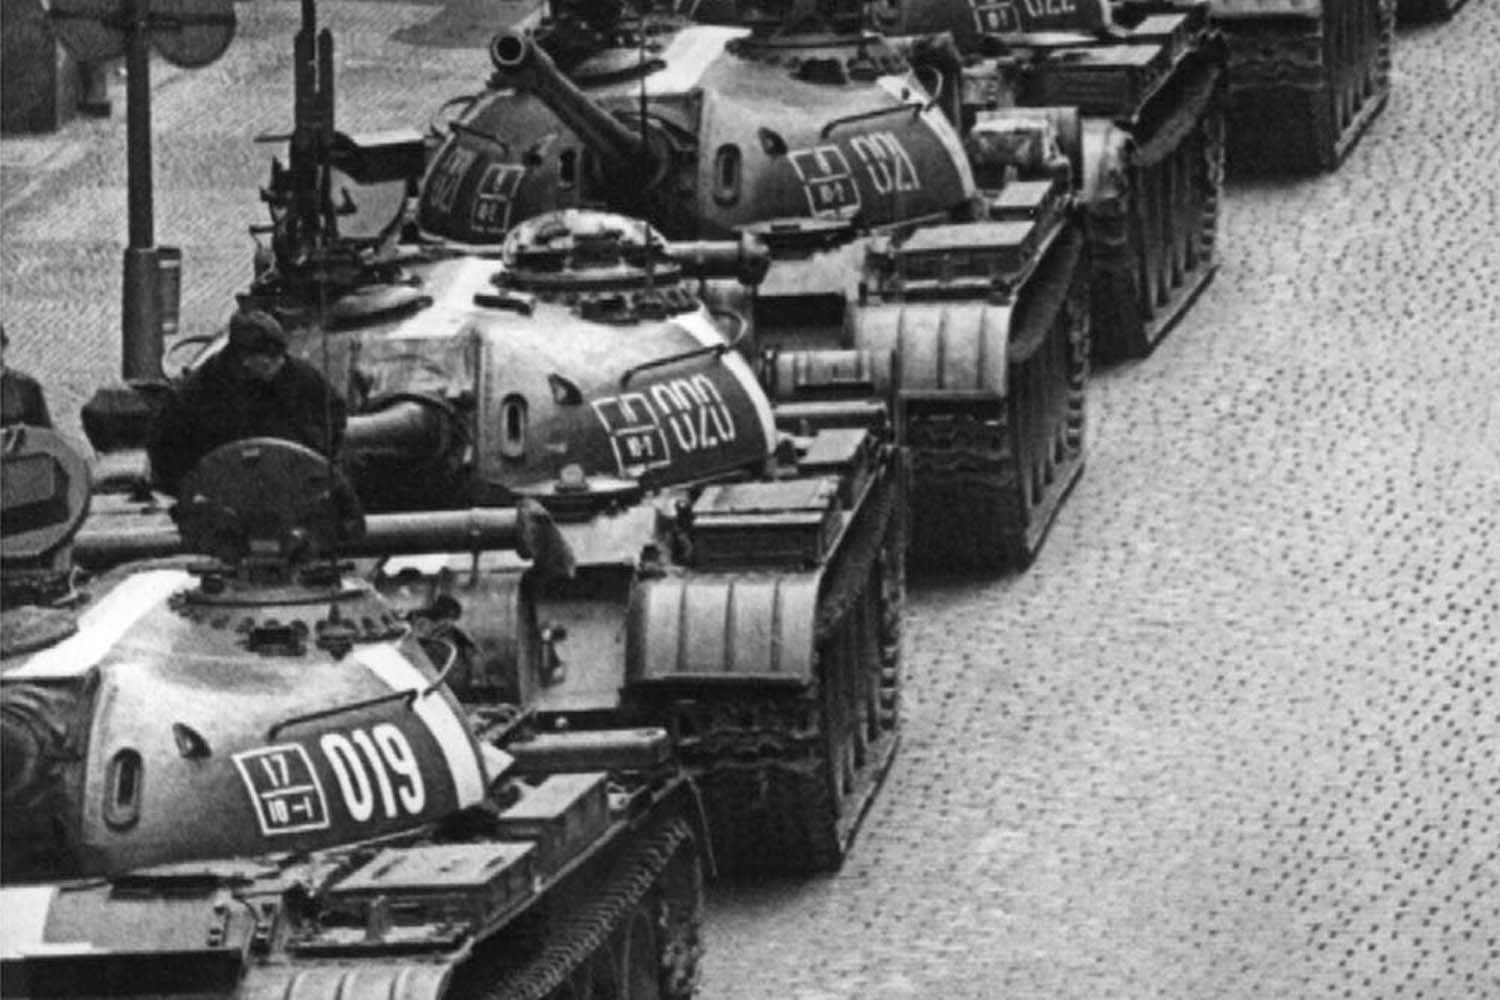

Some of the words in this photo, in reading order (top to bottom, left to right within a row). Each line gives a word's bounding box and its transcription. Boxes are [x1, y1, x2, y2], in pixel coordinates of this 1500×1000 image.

[851, 130, 921, 195] 021
[651, 372, 736, 453] 020
[260, 753, 290, 788] 17
[320, 722, 426, 822] 019
